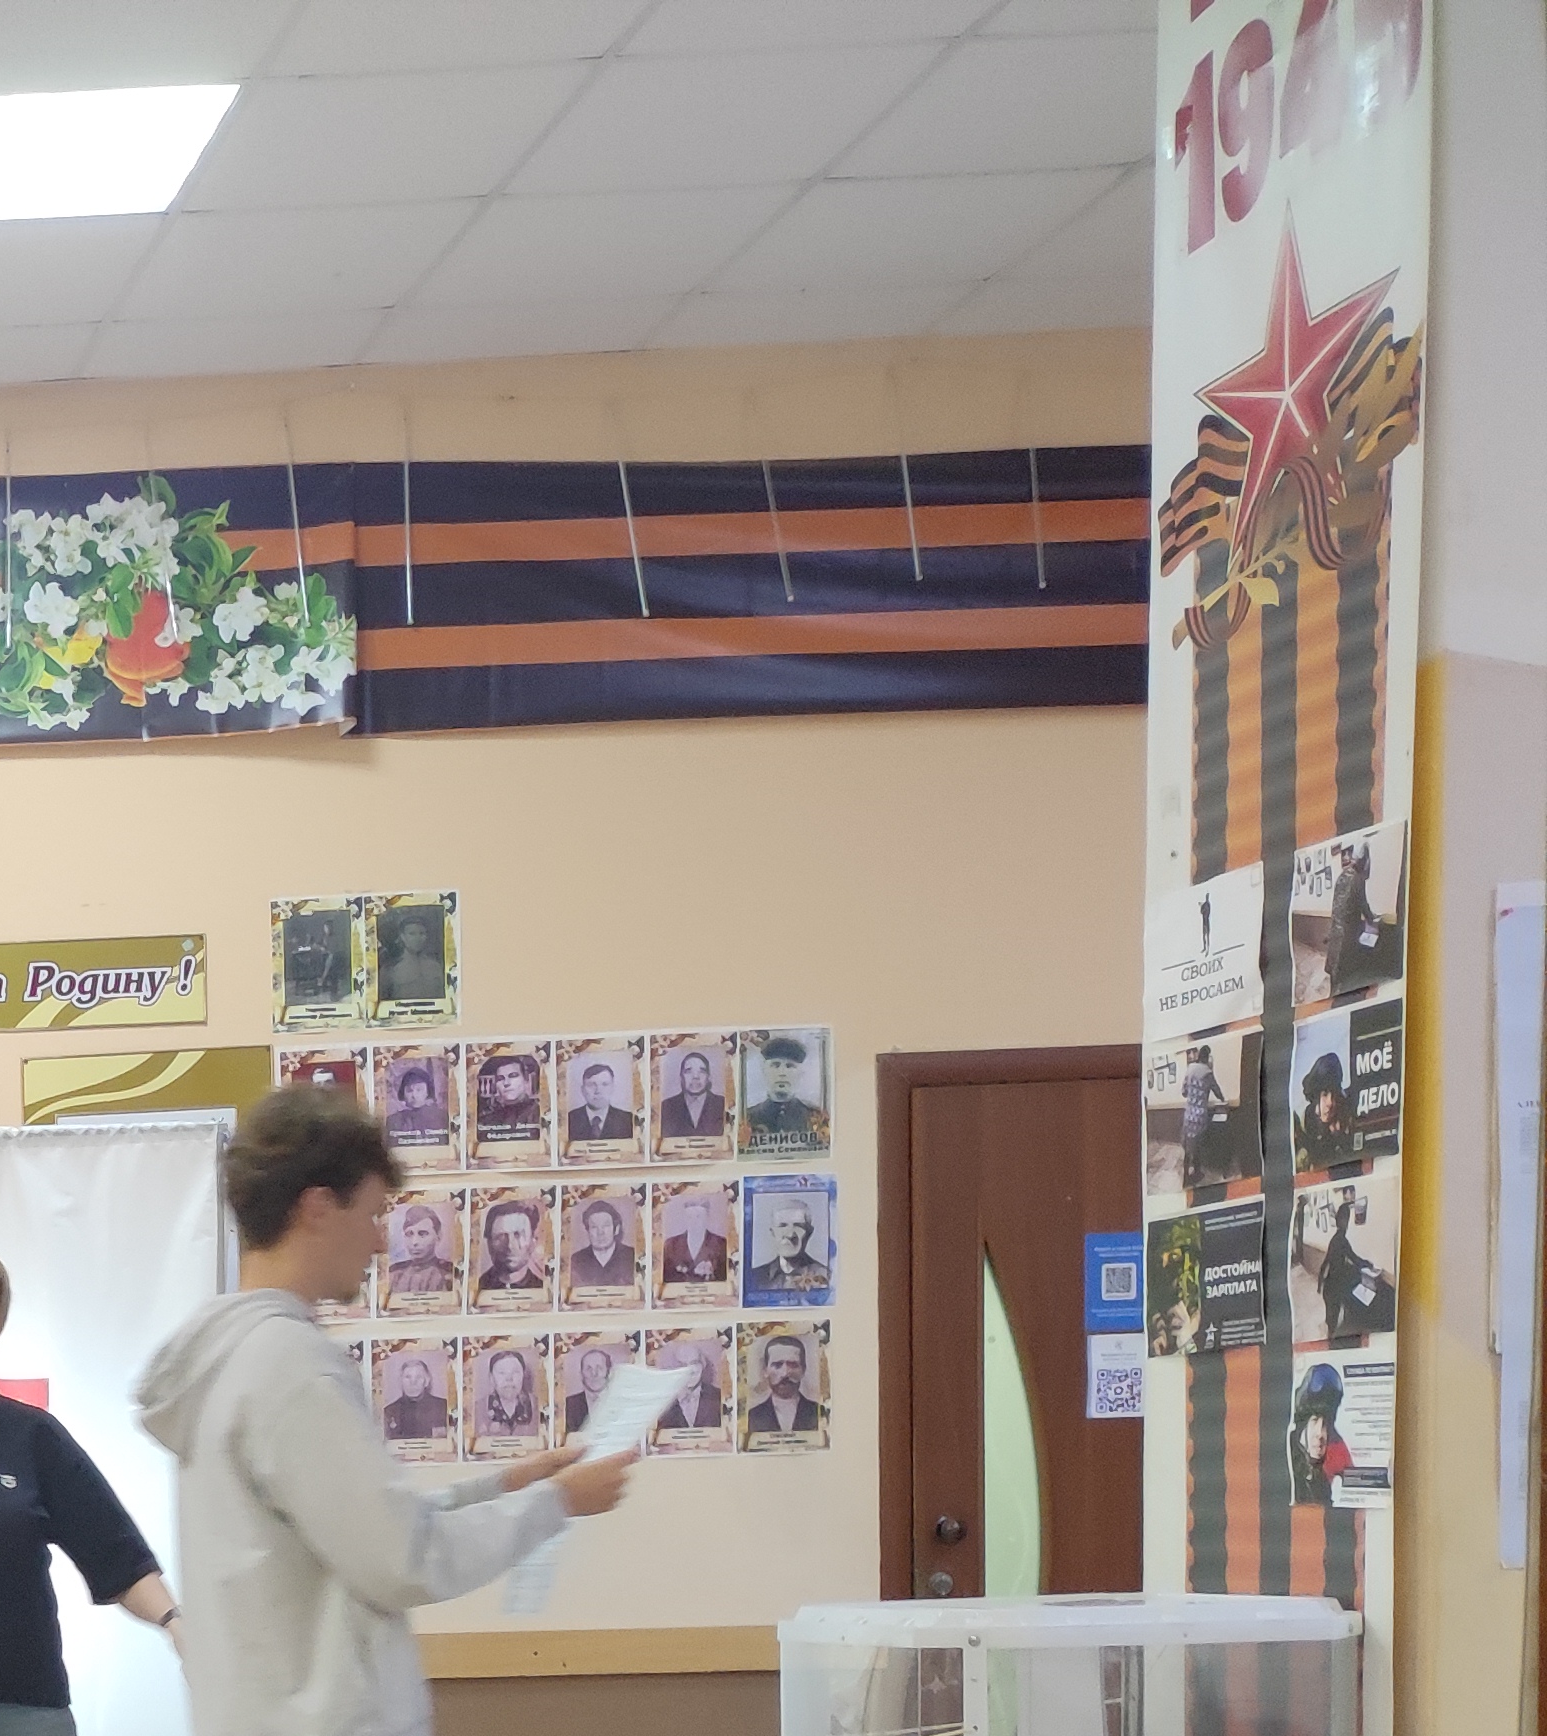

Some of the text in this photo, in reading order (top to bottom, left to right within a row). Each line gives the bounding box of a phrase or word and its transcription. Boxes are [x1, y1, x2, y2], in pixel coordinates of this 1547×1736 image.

[1181, 956, 1224, 981] СВОИХ
[1159, 975, 1244, 1012] НЕ БРОСАЕМ
[1356, 1040, 1393, 1076] МОЁ
[1357, 1082, 1399, 1116] ДЕЛО
[749, 1132, 818, 1147] ДЕНИСОВ
[1206, 1279, 1258, 1298] ЗАРПЛАТА
